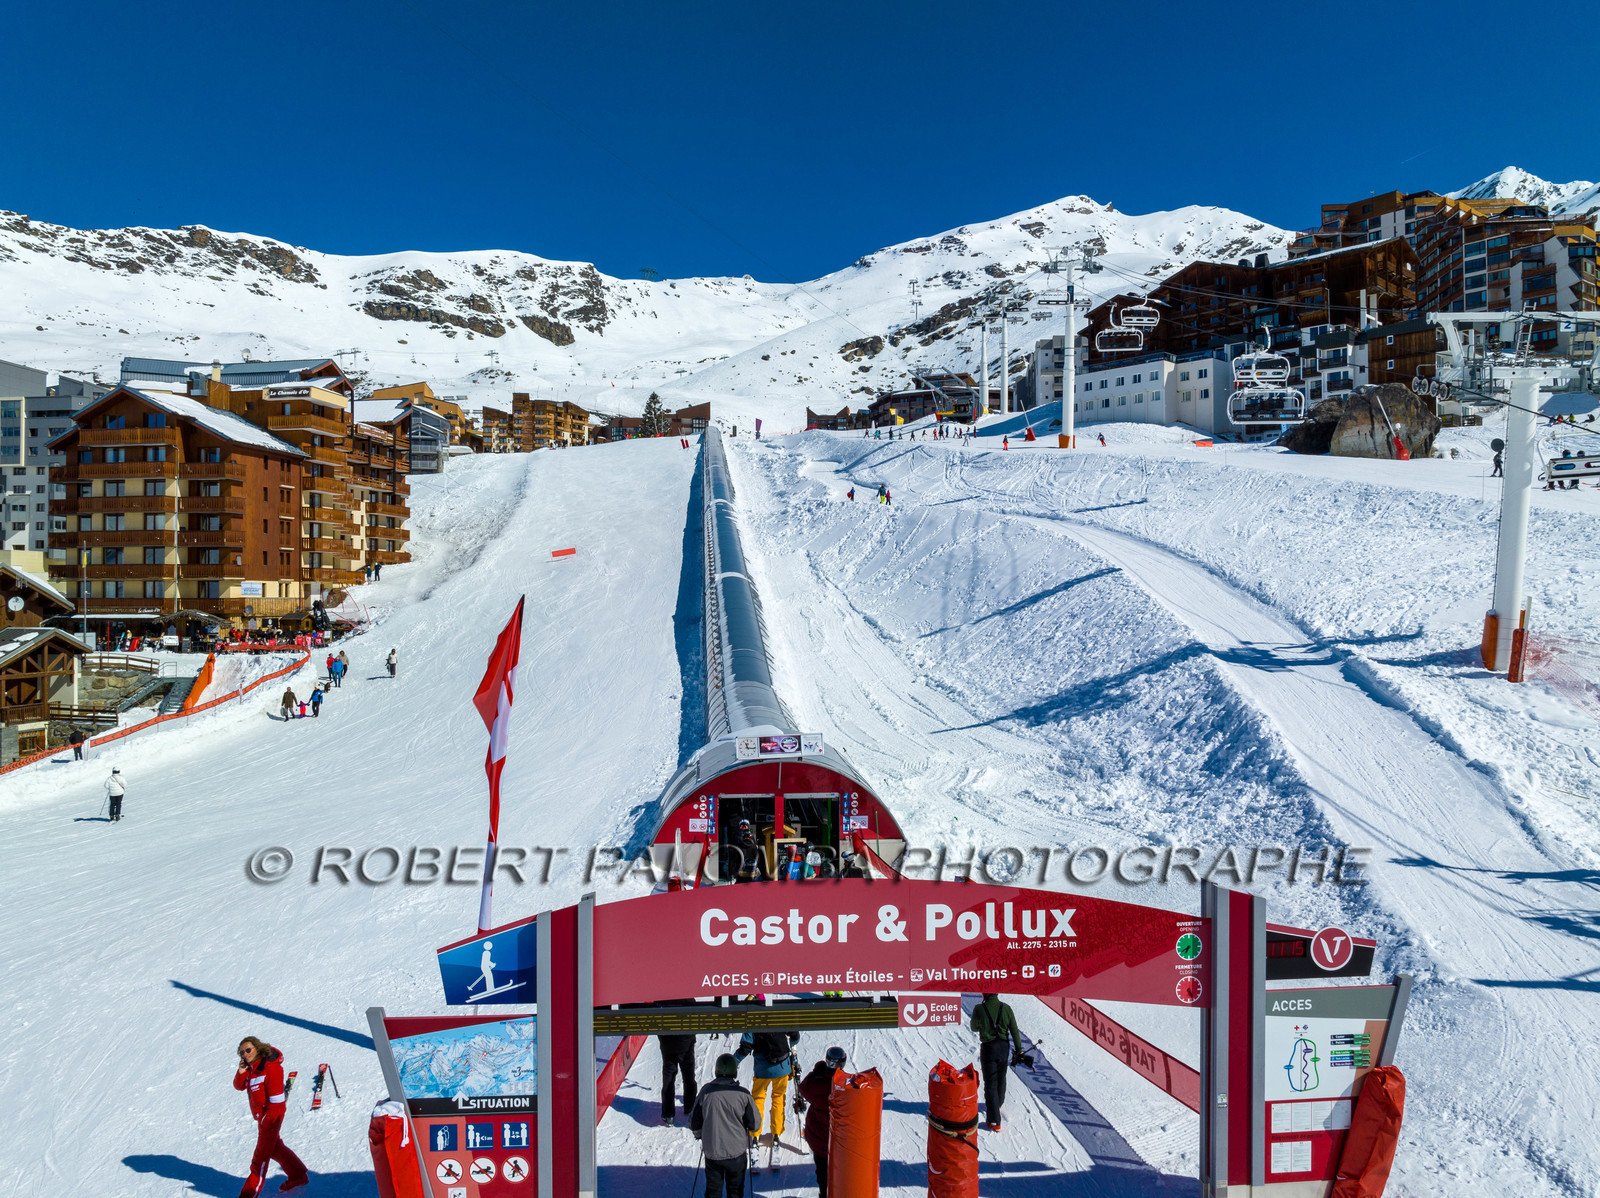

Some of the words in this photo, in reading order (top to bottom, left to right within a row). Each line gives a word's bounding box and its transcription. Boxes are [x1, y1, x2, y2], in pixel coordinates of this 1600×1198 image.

[1564, 320, 1572, 329] 2
[700, 908, 859, 946] Castor
[875, 904, 909, 942] &
[925, 902, 1077, 941] Pollux
[1006, 941, 1021, 949] Alt.
[1022, 941, 1042, 949] 2275
[1048, 940, 1067, 948] 2315
[701, 973, 750, 987] ACCES
[778, 972, 814, 985] Piste
[816, 974, 841, 985] aux
[846, 968, 894, 984] Étoiles
[926, 968, 948, 981] Val
[951, 967, 1008, 981] Thorens
[930, 1003, 958, 1012] Ecoles
[1272, 999, 1313, 1012] ACCES
[930, 1013, 941, 1022] de
[942, 1013, 956, 1022] ski
[469, 1098, 530, 1109] SITUATION
